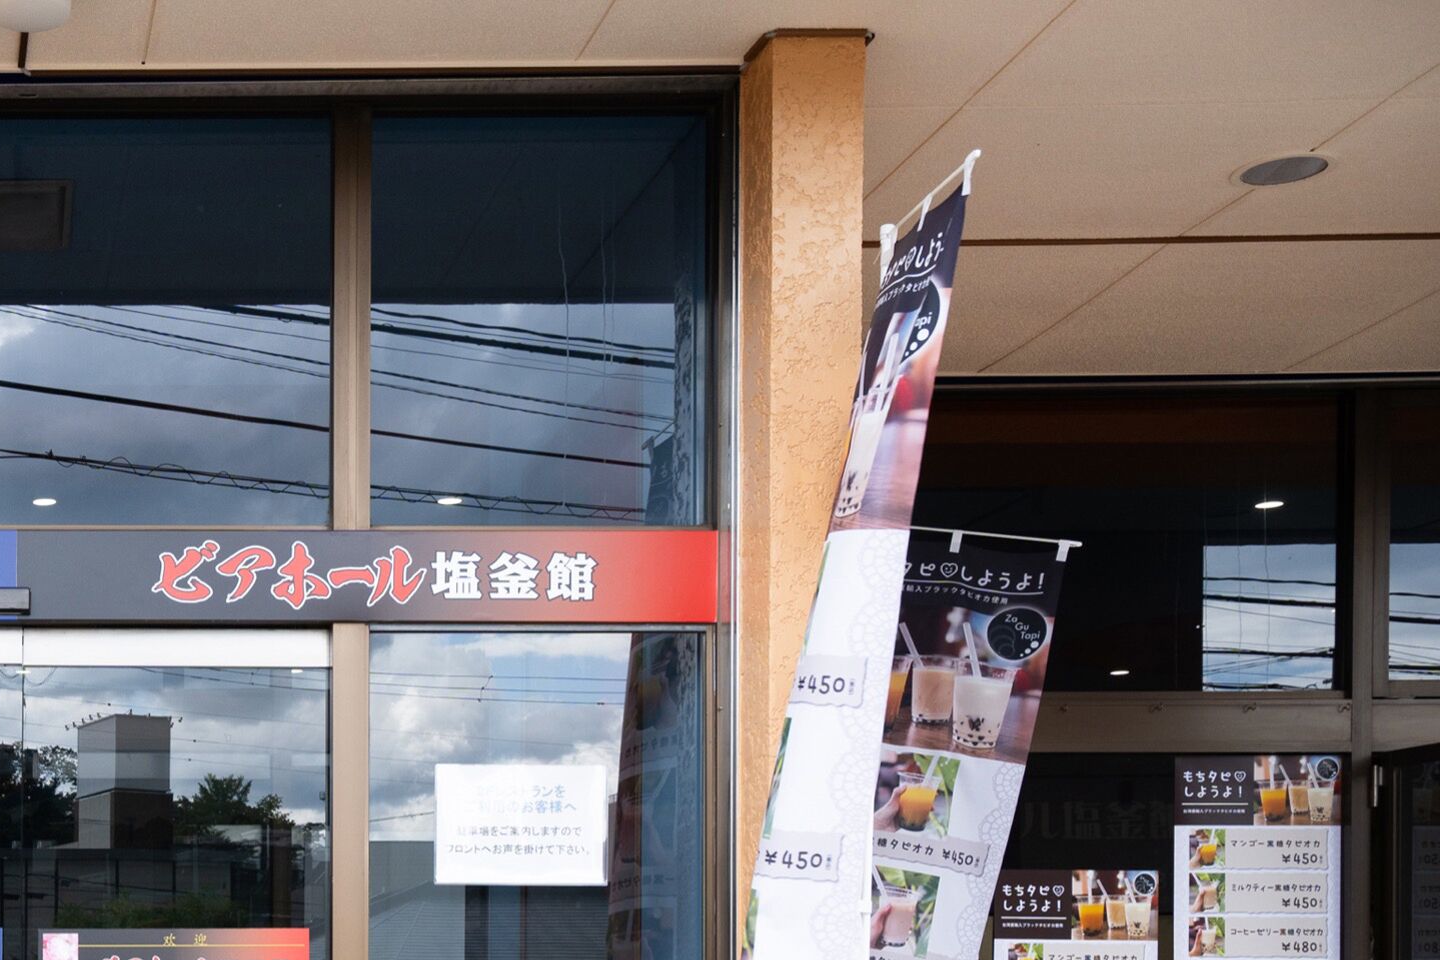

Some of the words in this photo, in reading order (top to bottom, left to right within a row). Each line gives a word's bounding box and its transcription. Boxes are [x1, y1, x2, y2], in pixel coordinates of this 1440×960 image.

[152, 539, 598, 610] ビアホール塩釜館
[1020, 630, 1041, 641] Tapi
[797, 674, 846, 695] ¥450
[1182, 770, 1232, 782] もちタピ
[872, 838, 934, 857] 糖タピオカ
[942, 848, 974, 866] ¥450
[764, 849, 823, 870] ¥450
[1281, 852, 1318, 865] ¥450
[1002, 884, 1050, 896] もちタピ
[1281, 897, 1318, 909] ¥450
[1281, 941, 1318, 953] ¥480
